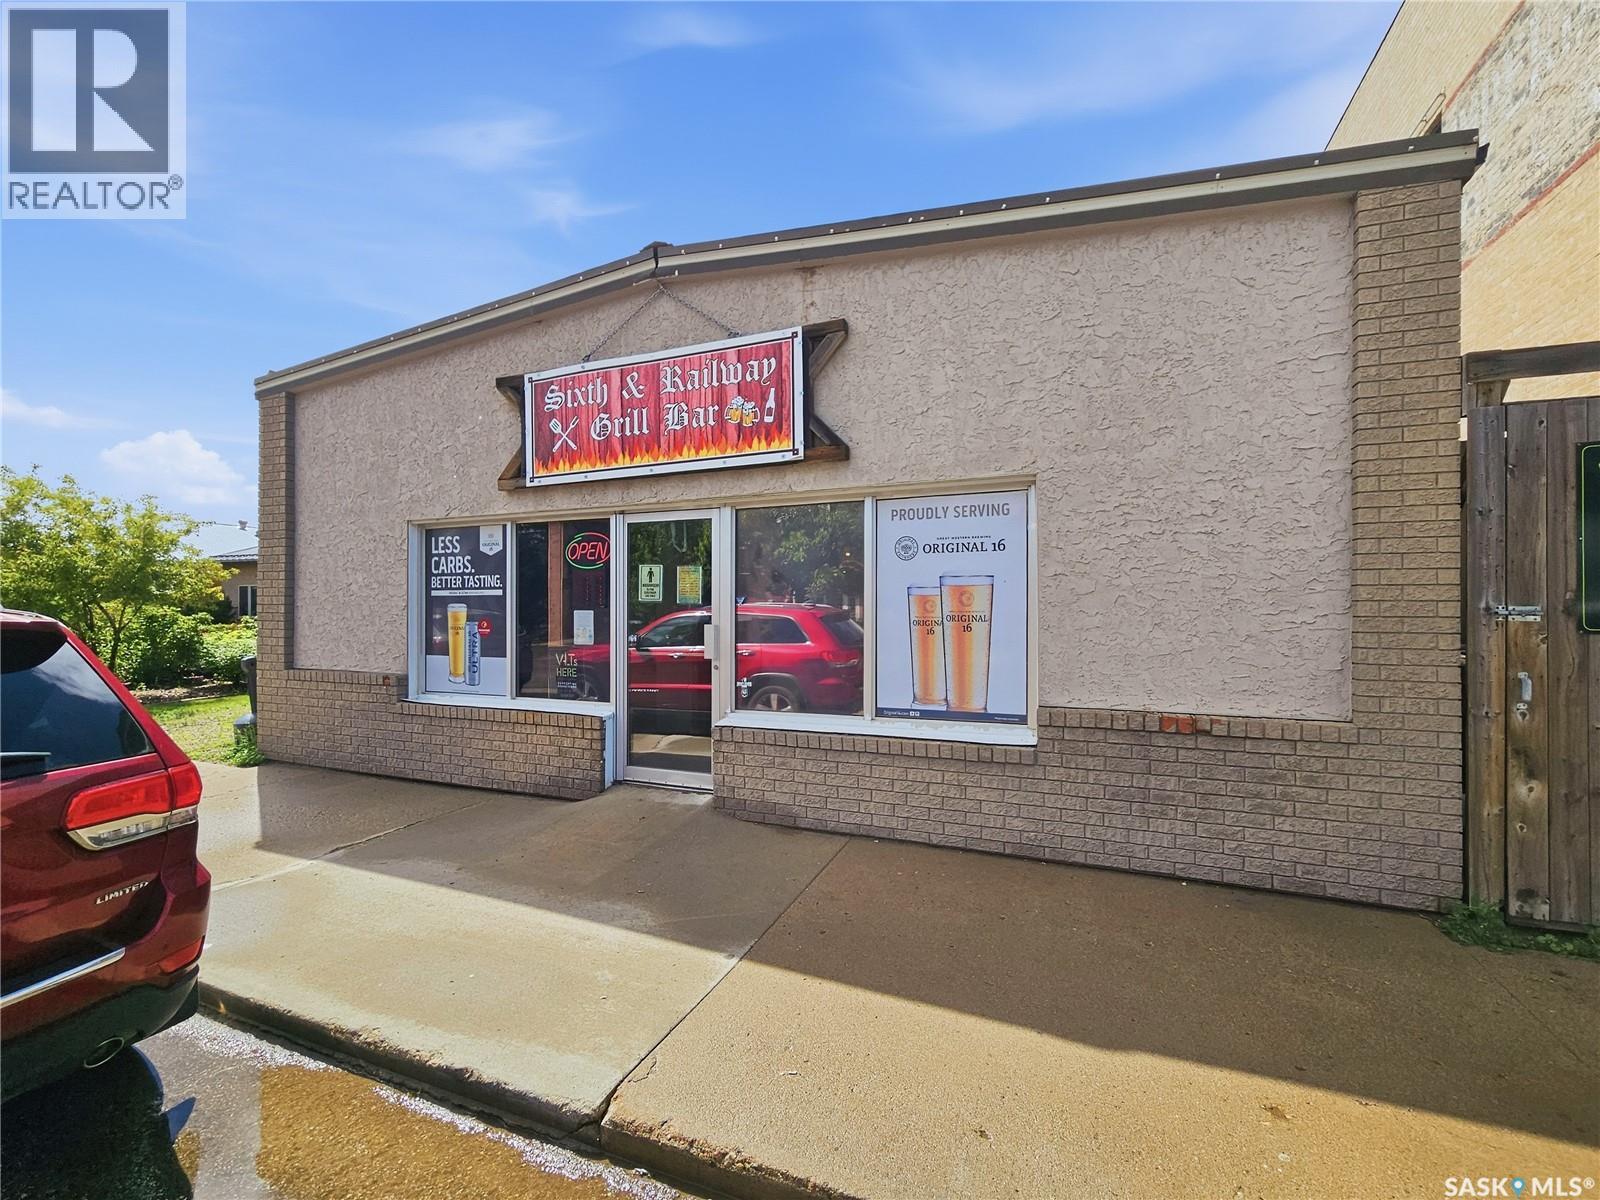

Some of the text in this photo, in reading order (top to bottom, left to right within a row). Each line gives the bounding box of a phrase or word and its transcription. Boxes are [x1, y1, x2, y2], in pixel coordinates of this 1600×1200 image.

[544, 356, 777, 413] Sixth & Railway
[589, 400, 720, 441] Grill Bar
[891, 502, 1010, 521] PROUDLY SERVING
[431, 535, 460, 554] LESS
[568, 541, 608, 560] OPEN
[922, 541, 988, 554] ORIGINAL
[991, 538, 1006, 552] 16
[431, 555, 475, 574] CARBS.
[431, 574, 503, 588] BETTER TASTING.
[945, 614, 988, 623] ORIGINAL
[962, 623, 973, 633] 16
[926, 626, 935, 635] 16
[556, 667, 577, 678] HERE
[96, 881, 149, 905] LIMITED
